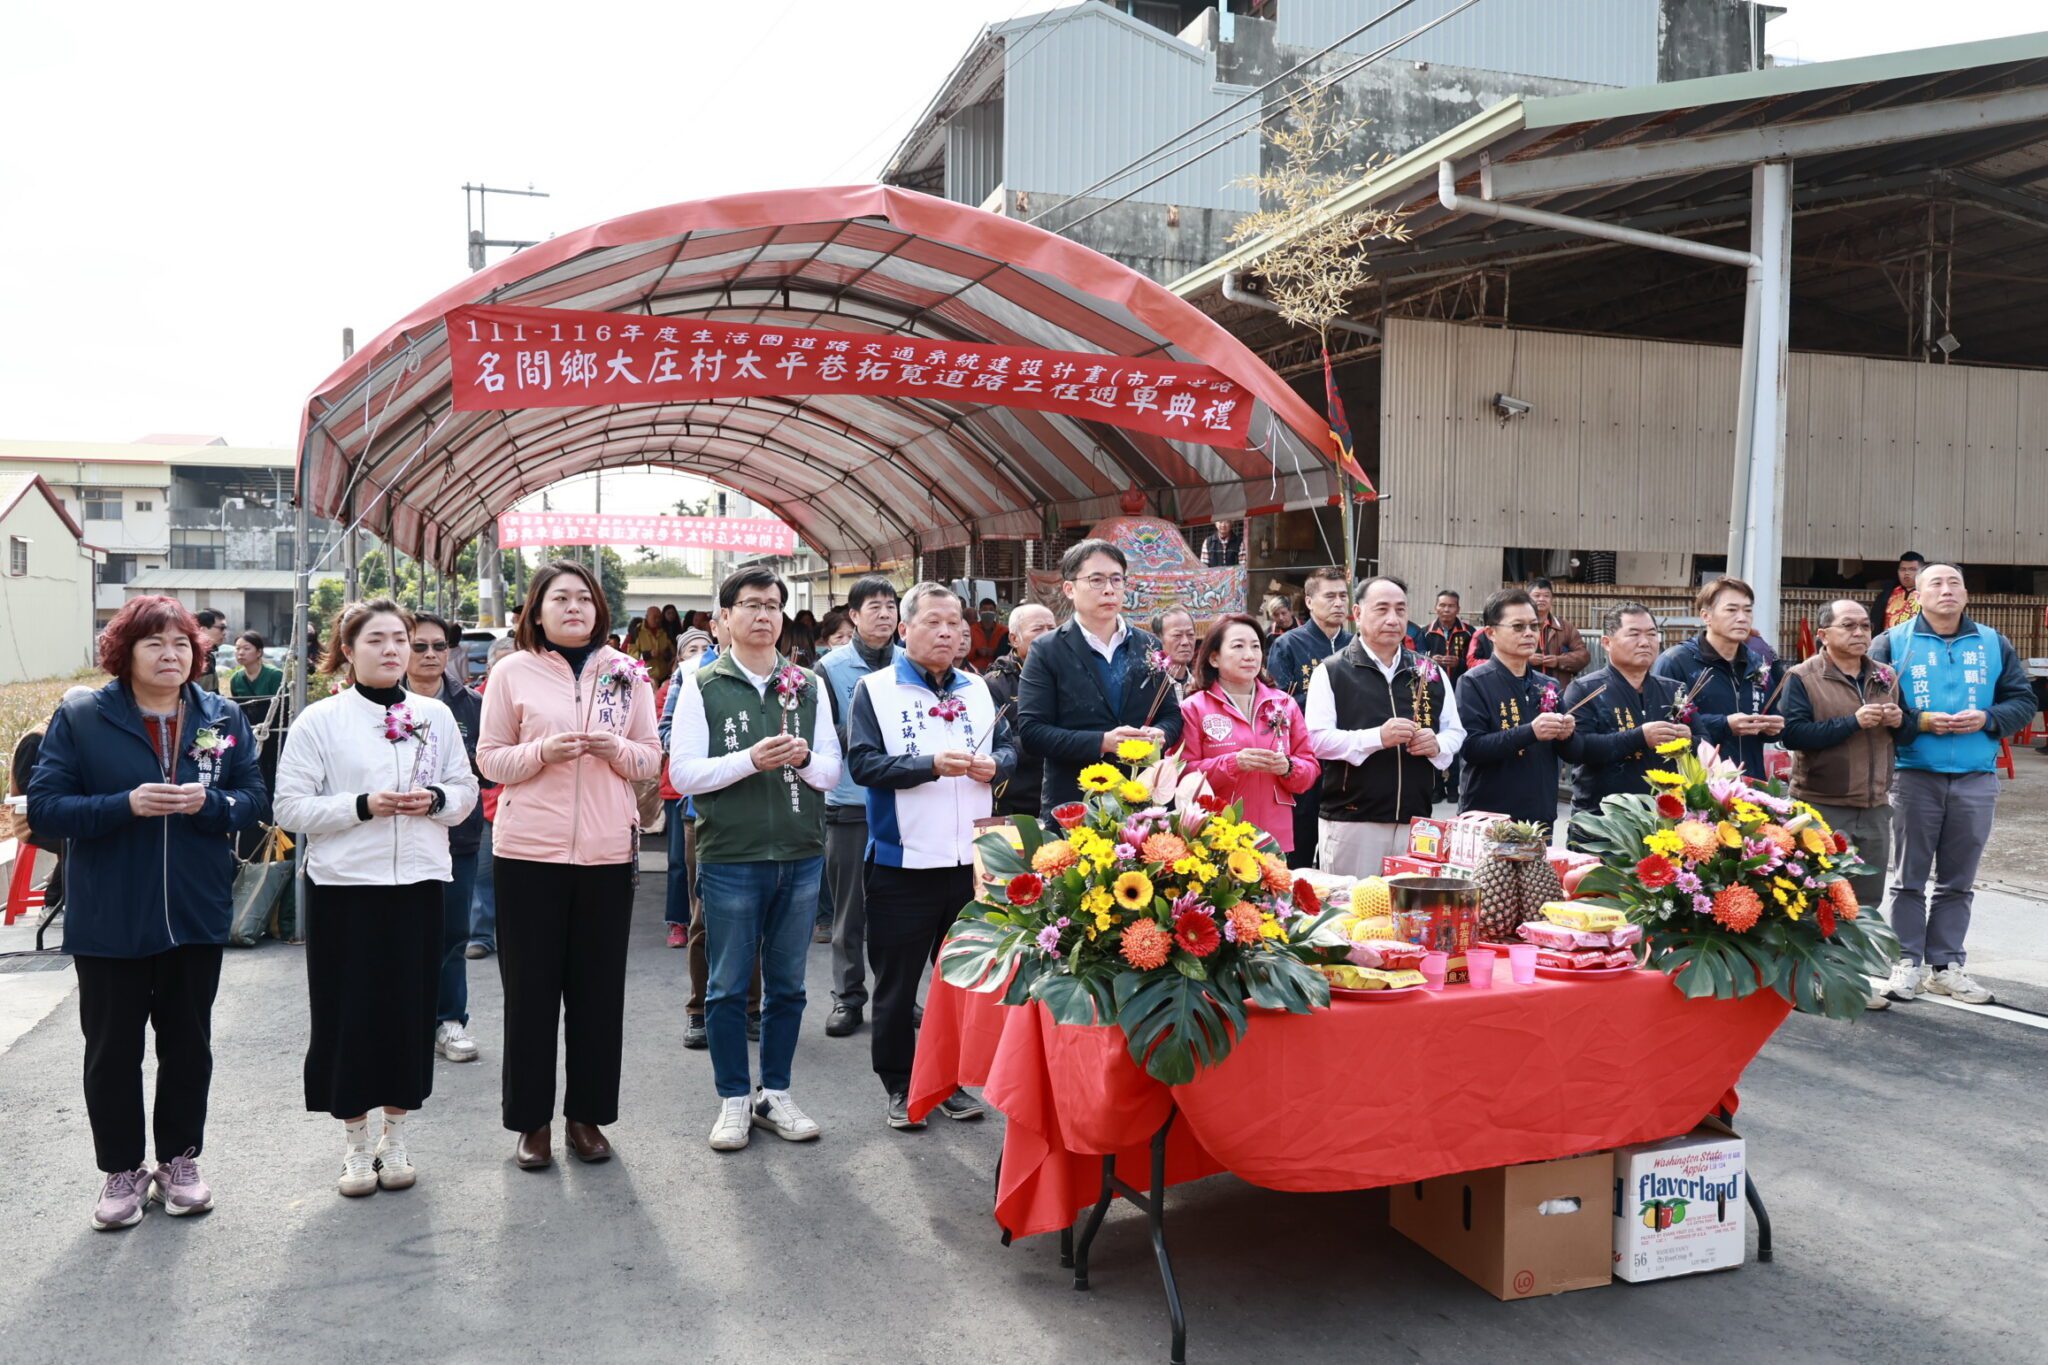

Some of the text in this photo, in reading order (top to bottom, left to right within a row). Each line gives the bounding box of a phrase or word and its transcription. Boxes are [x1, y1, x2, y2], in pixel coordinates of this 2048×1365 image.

[474, 348, 1237, 431] 名間鄉大庄村太平巷拓寬道路工程通車典禮
[1911, 665, 1931, 709] 蔡政軒
[738, 710, 750, 733] 議員
[724, 717, 740, 753] 吳棋
[1654, 1154, 1700, 1169] Washington
[1700, 1150, 1723, 1162] State
[1681, 1163, 1709, 1176] Apples
[1634, 1252, 1648, 1267] 56
